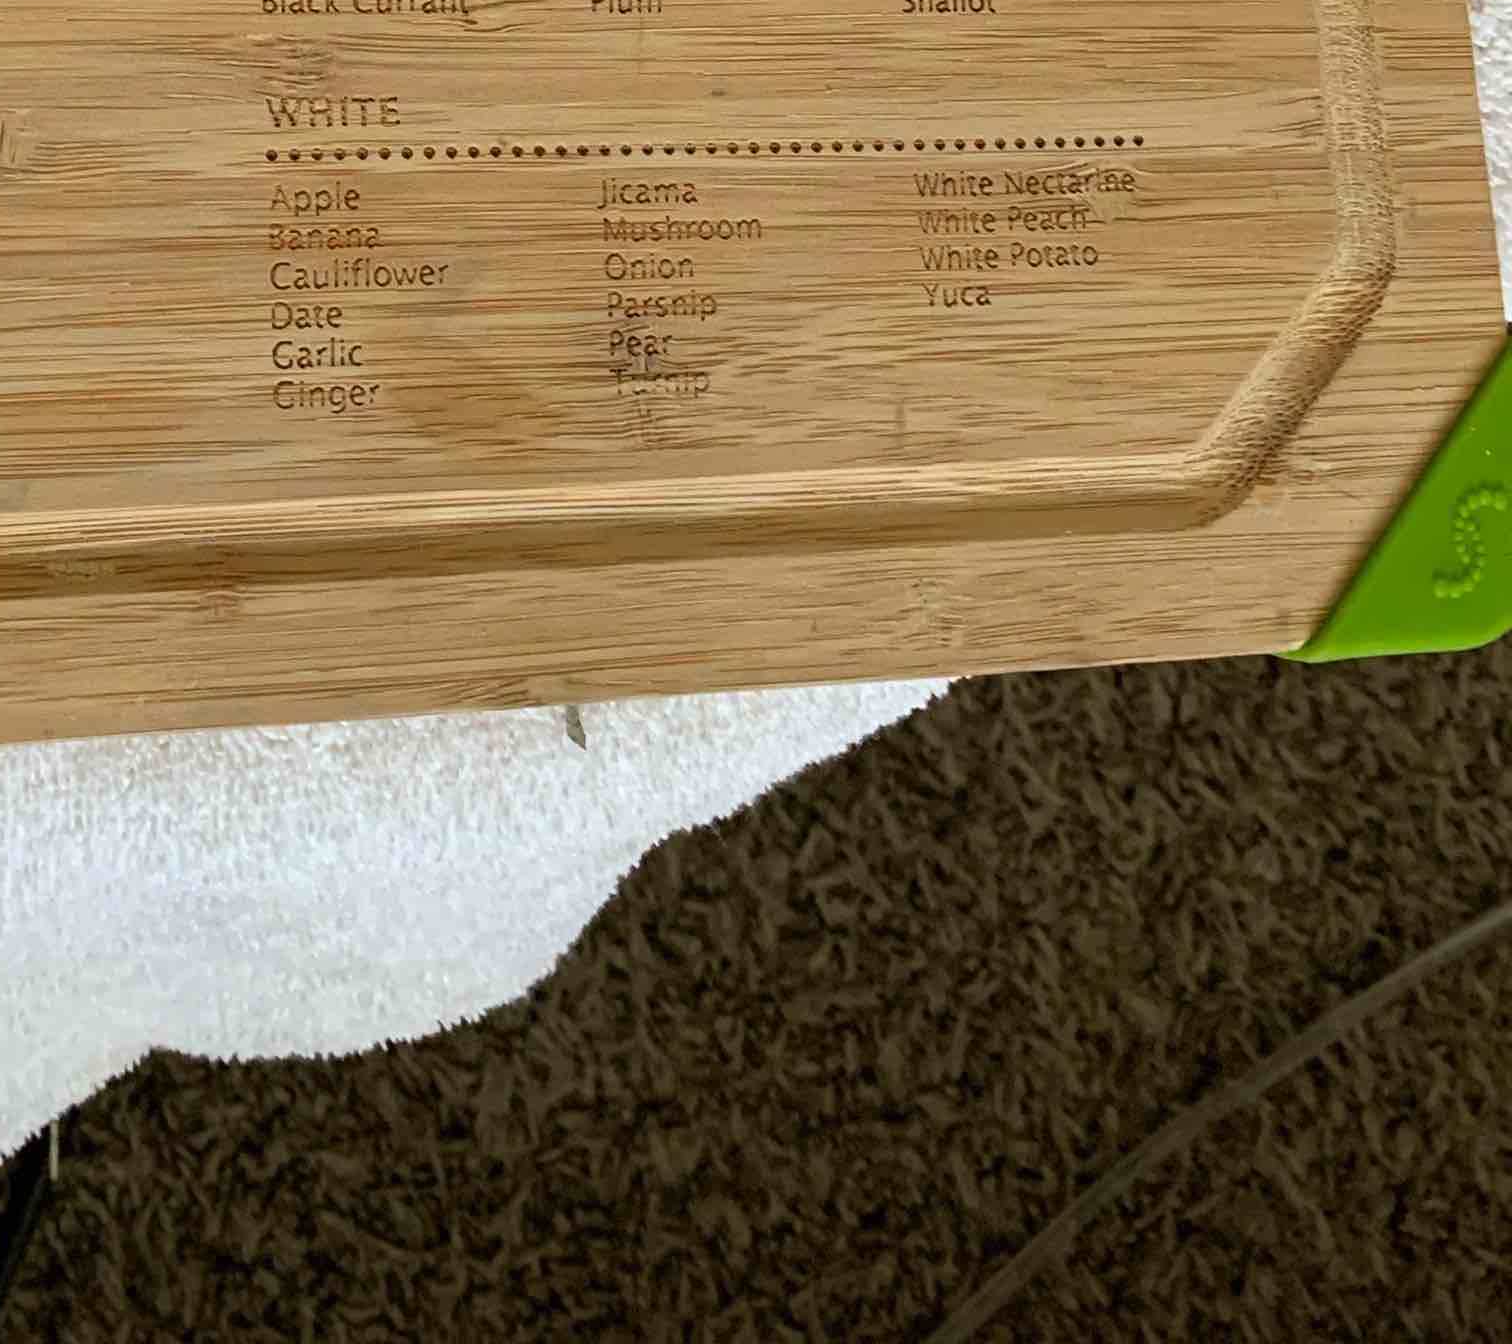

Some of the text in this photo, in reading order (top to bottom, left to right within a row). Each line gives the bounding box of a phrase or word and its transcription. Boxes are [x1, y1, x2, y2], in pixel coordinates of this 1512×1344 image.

[266, 96, 401, 128] WHITE
[270, 181, 361, 215] Apple
[597, 177, 699, 210] Jicama
[914, 169, 1137, 199] White Nectarine
[602, 215, 763, 242] Mushroom
[916, 206, 1088, 234] White Peach
[268, 221, 386, 251] Banana
[604, 253, 695, 280] Onion
[919, 241, 1099, 270] White Potato
[269, 258, 449, 291] Cauliflower
[607, 290, 718, 320] Parsnip
[922, 282, 992, 308] Yuca
[270, 301, 343, 330] Date
[272, 337, 364, 370] Garlic
[610, 328, 672, 356] Pear
[273, 381, 380, 413] Ginger
